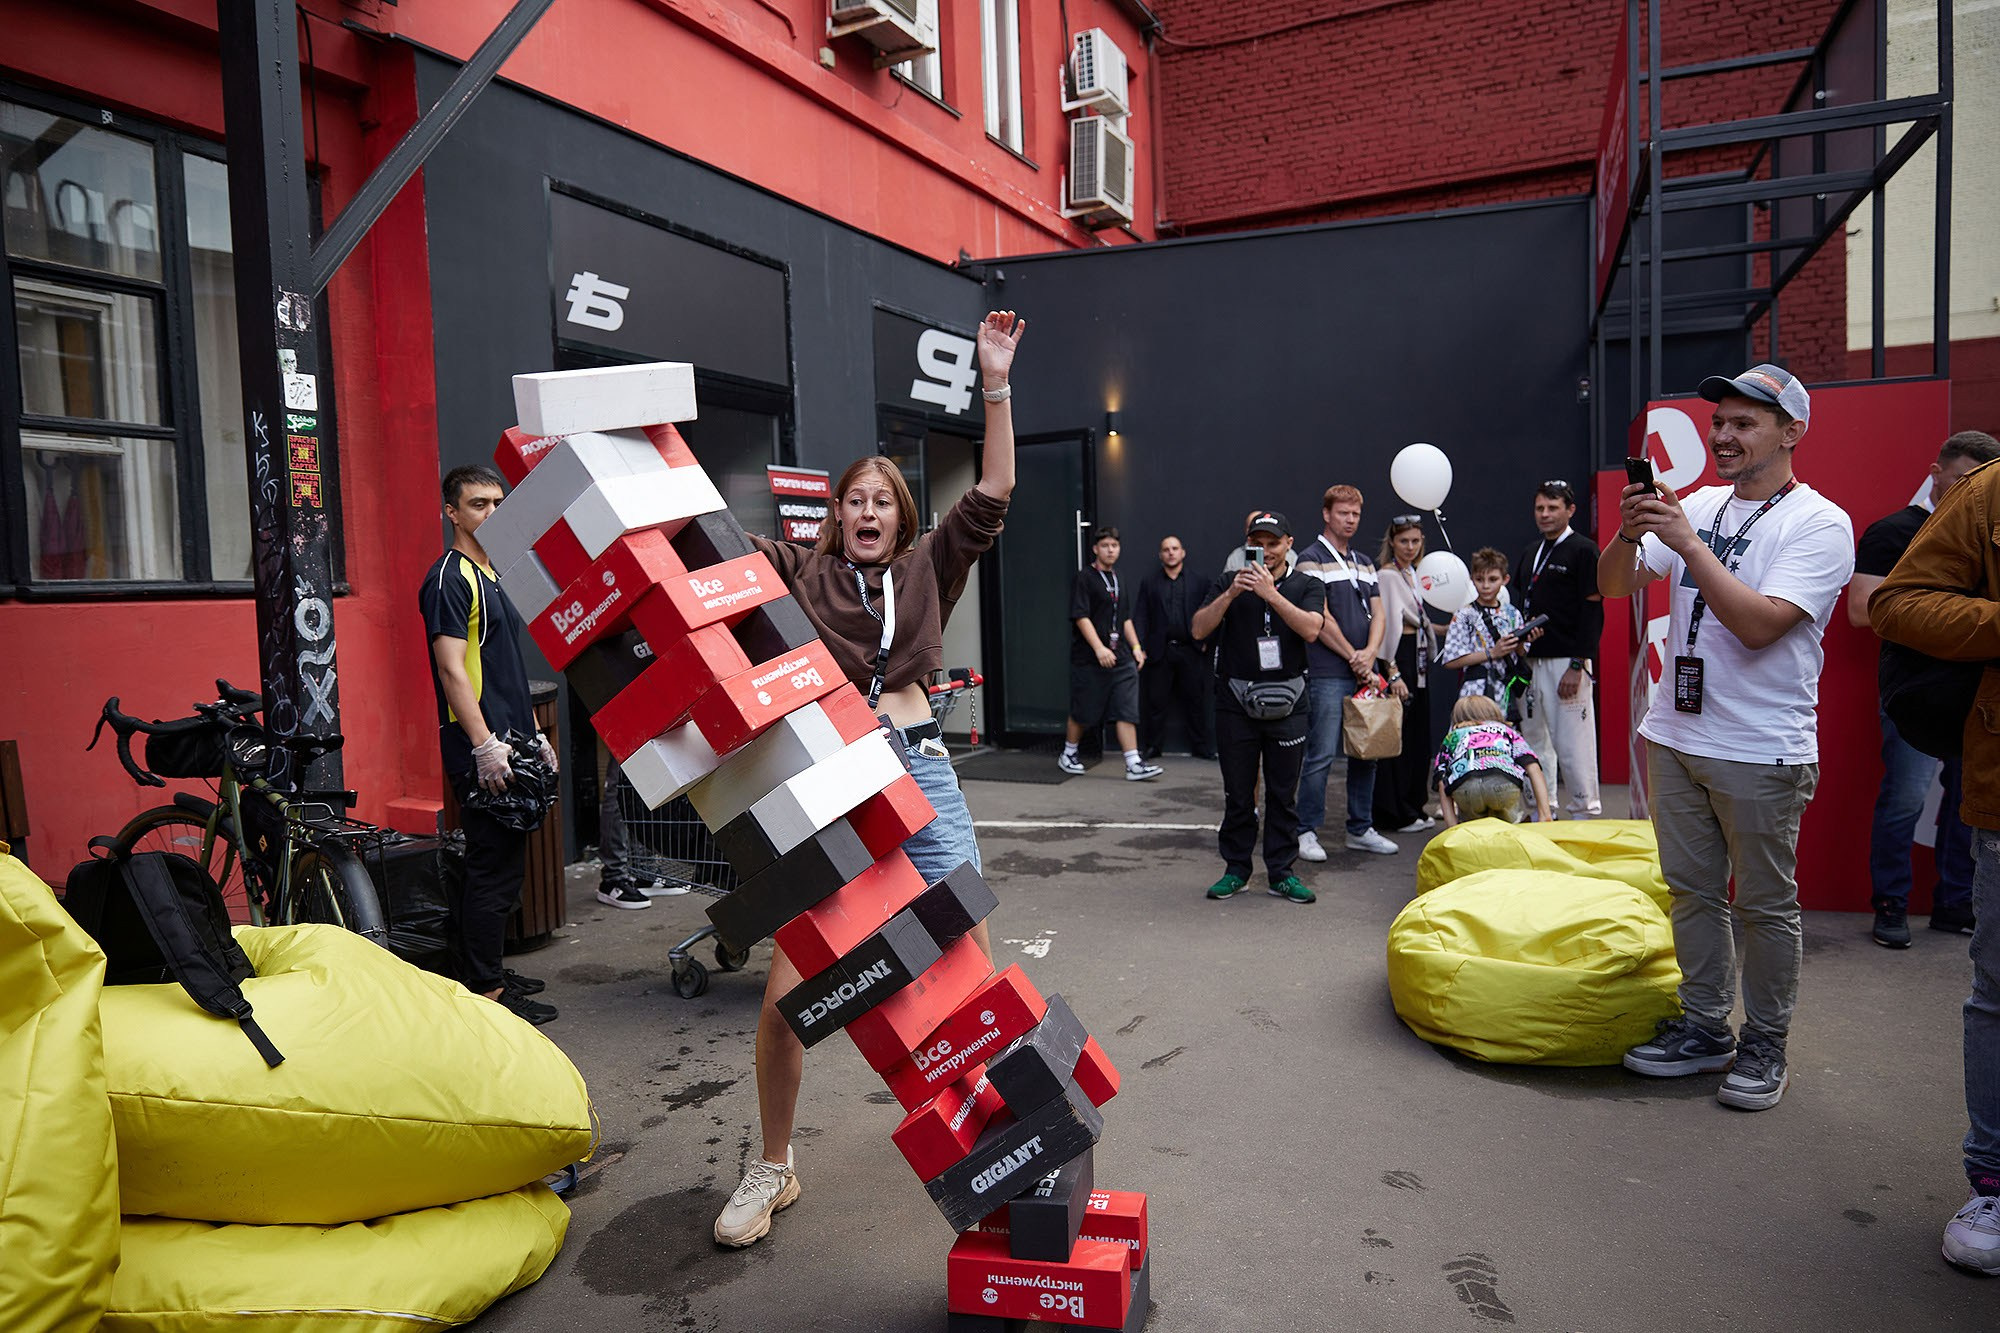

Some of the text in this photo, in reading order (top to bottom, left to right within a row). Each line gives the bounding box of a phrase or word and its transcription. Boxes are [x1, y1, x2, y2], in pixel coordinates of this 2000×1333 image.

[688, 577, 724, 598] Все
[703, 586, 763, 610] инструменты
[550, 599, 584, 633] Все
[565, 589, 622, 645] инструменты
[751, 656, 809, 688] инструменты
[791, 667, 824, 690] Все
[797, 959, 893, 1028] INFORCE
[910, 1039, 952, 1071] Все
[924, 1027, 1001, 1083] инструменты
[950, 1103, 971, 1132] СТРОИТЬ
[971, 1135, 1044, 1194] GIGANT
[987, 1274, 1084, 1292] инструменты
[1039, 1293, 1085, 1319] Все
